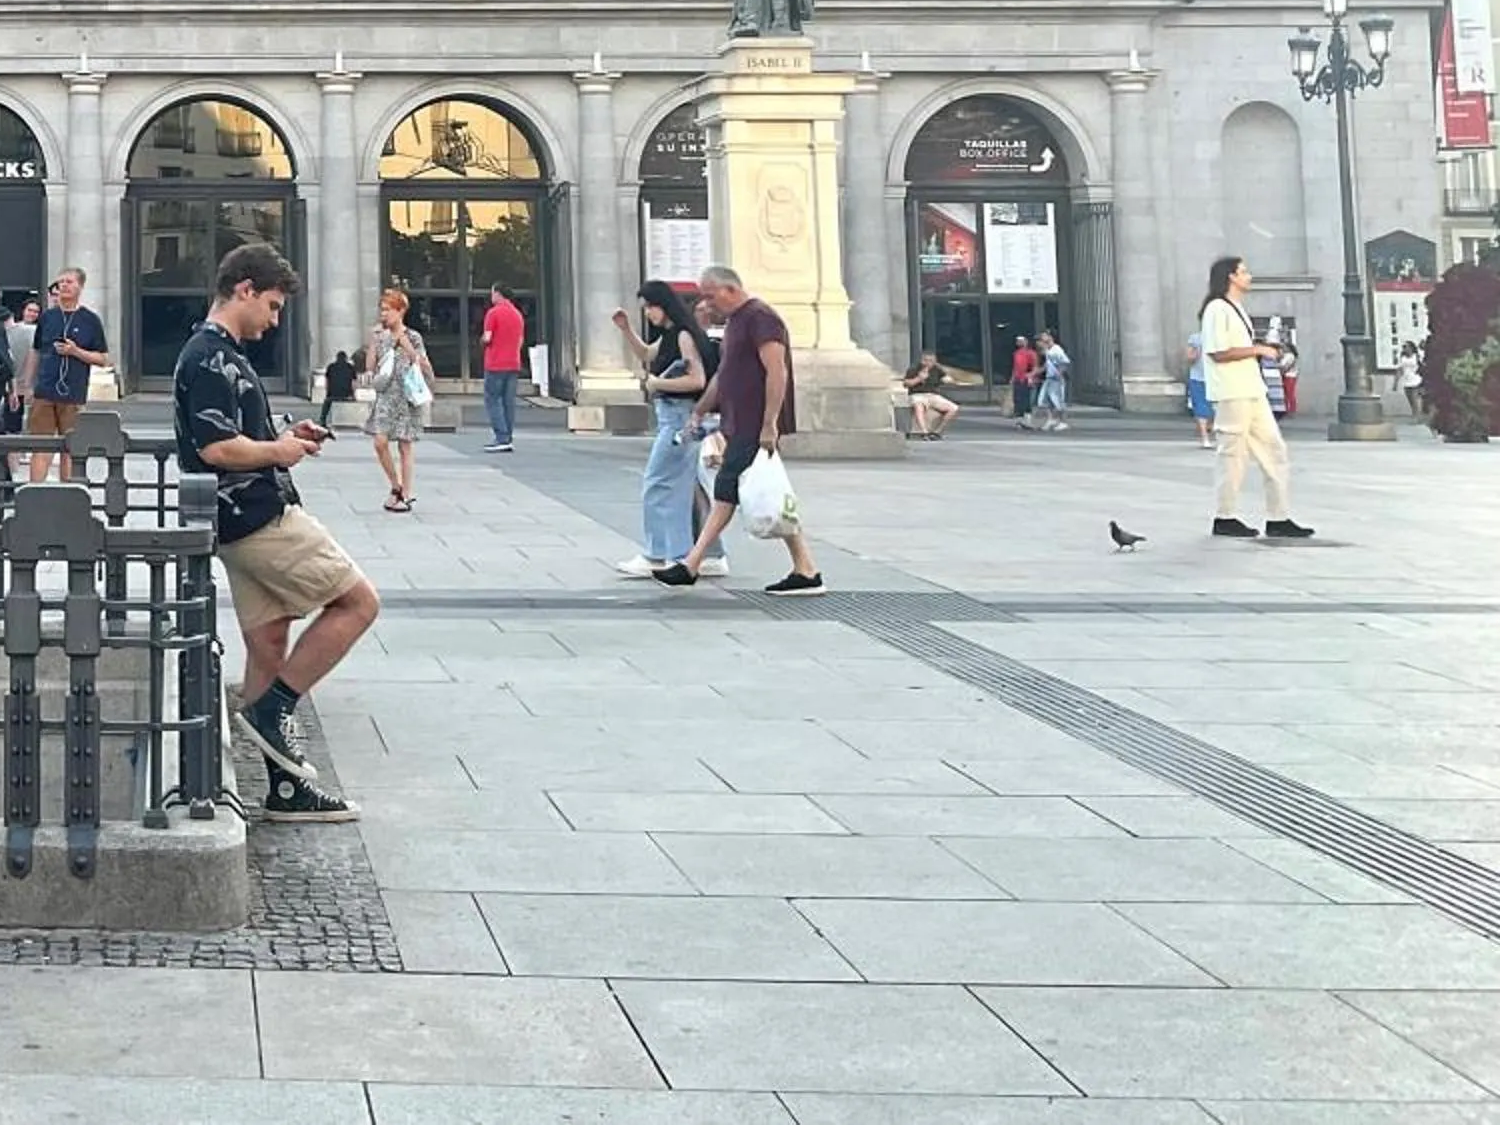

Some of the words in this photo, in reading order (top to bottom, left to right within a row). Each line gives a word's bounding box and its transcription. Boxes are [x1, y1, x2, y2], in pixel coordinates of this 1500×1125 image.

[747, 57, 789, 69] ISABEL
[963, 139, 1028, 148] TAQUILLAS
[959, 148, 983, 158] BOX
[987, 148, 1029, 158] OFFICE
